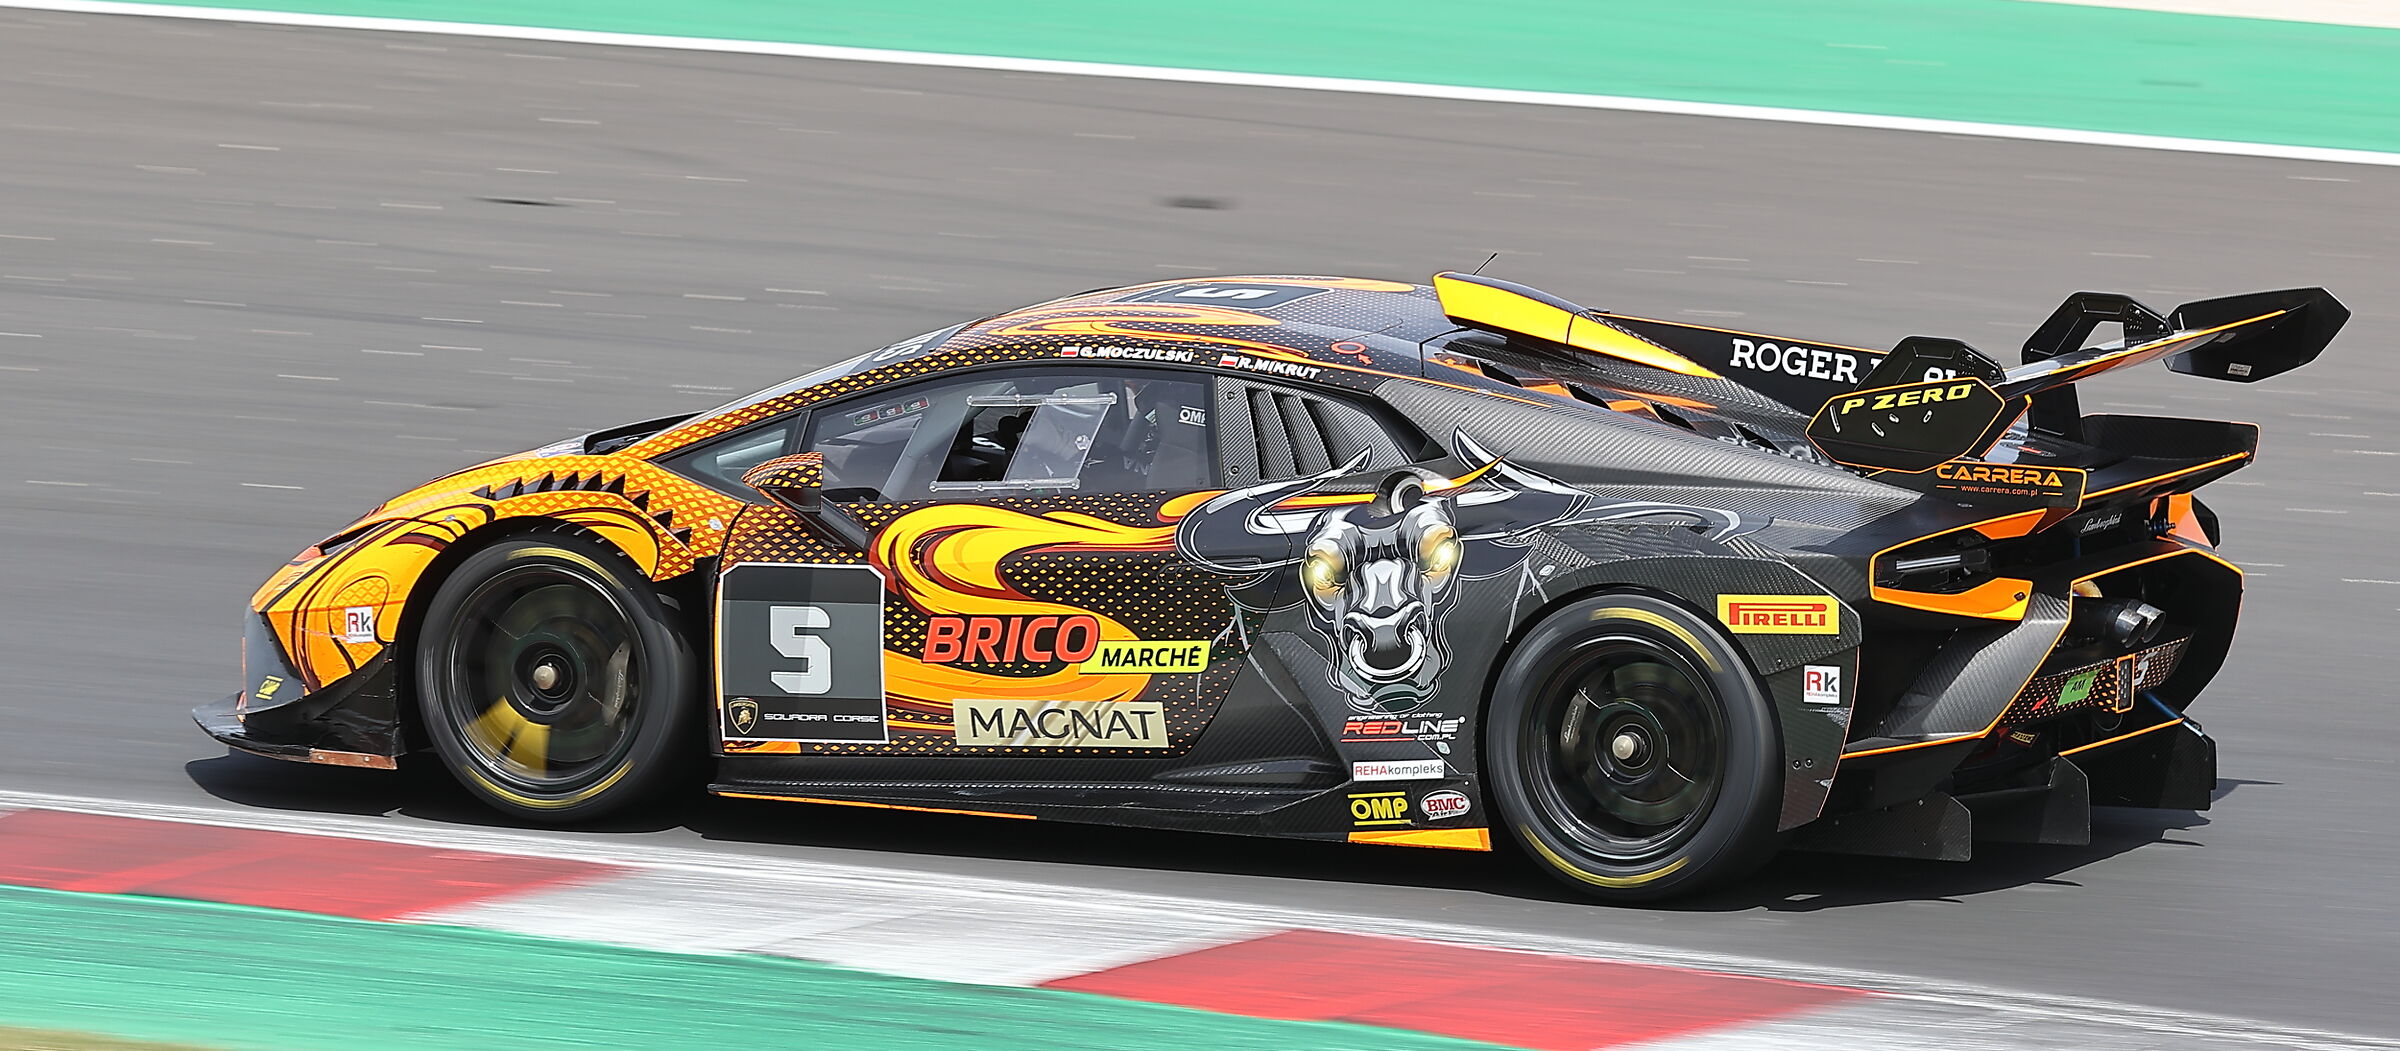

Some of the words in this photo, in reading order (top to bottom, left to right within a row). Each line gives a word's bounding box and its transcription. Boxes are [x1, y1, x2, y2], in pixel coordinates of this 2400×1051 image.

[1238, 355, 1321, 379] R.MIKRUT
[1729, 338, 1859, 384] ROGER
[1841, 398, 1866, 415] P
[1871, 383, 1973, 411] ZERO
[1936, 465, 2063, 487] CARRERA
[1960, 485, 2038, 497] www.carrera.com.pl
[347, 611, 372, 632] Rk
[1729, 603, 1827, 626] PIRELLI
[770, 605, 832, 694] 5
[922, 615, 1100, 664] BRICO
[1101, 645, 1202, 667] MARCHÉ
[1806, 671, 1837, 692] Rk
[2070, 679, 2086, 693] AM
[764, 713, 828, 722] SQUADRA
[833, 714, 879, 723] CORSE
[969, 707, 1156, 740] MAGNAT
[1342, 719, 1460, 735] REDLINE
[1355, 763, 1443, 777] REHAkompleks
[1351, 797, 1408, 820] OMP
[1426, 797, 1466, 812] BMC
